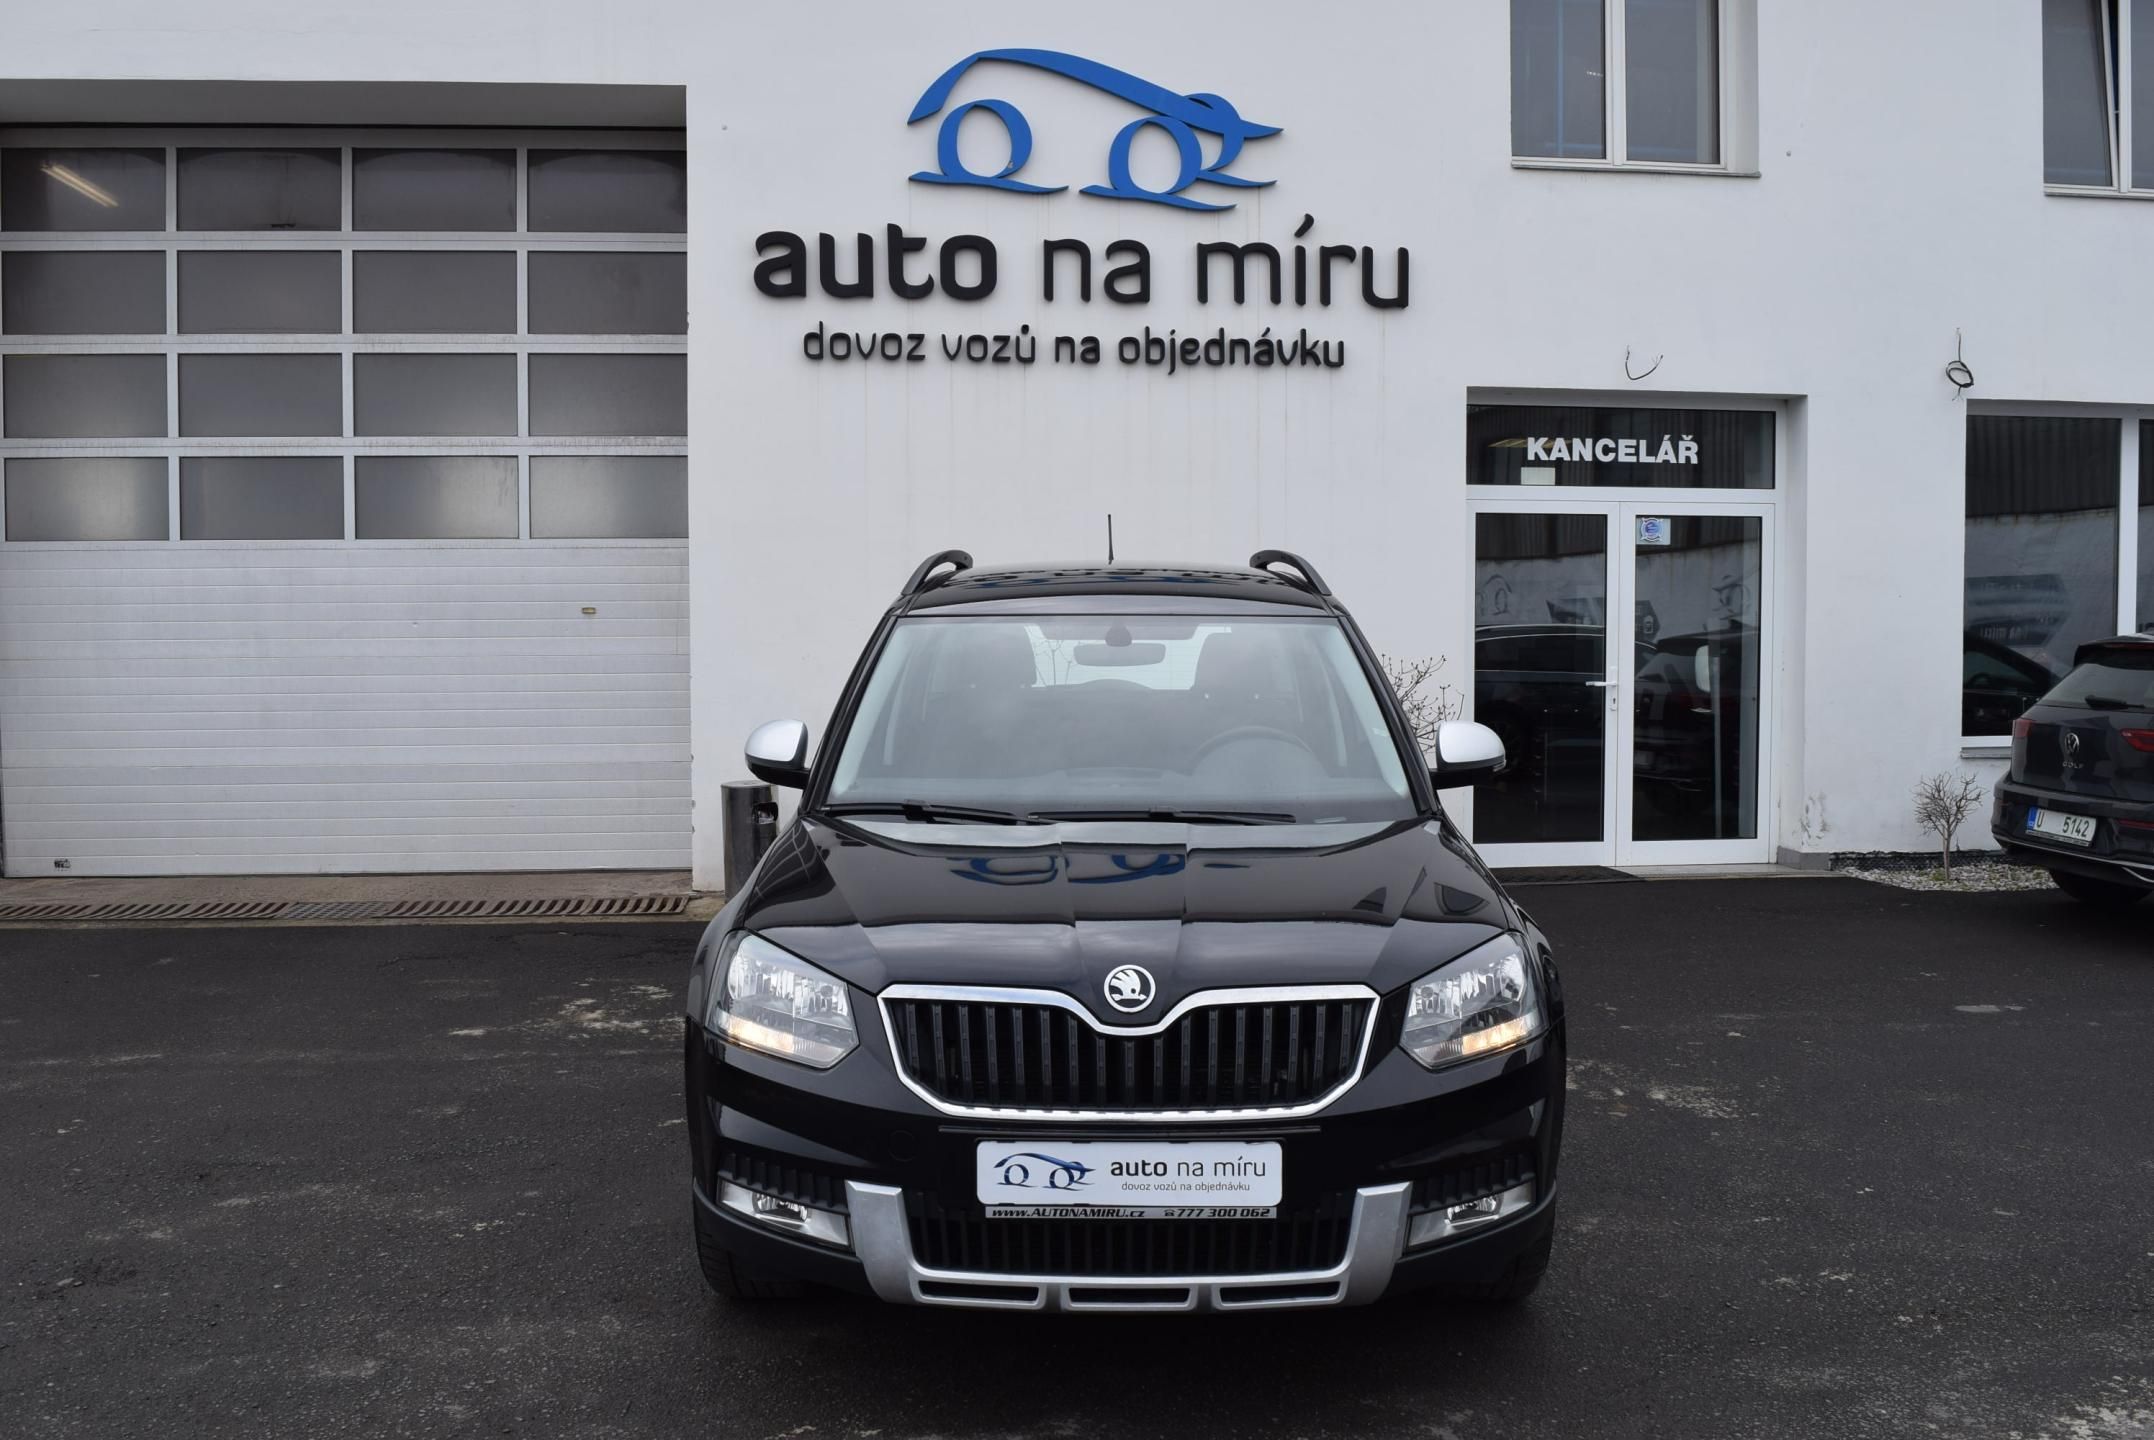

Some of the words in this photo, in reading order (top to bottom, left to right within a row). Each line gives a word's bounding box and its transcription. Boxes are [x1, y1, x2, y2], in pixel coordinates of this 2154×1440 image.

[753, 222, 998, 304] auto
[1043, 238, 1151, 306] na
[1196, 213, 1410, 310] míru
[803, 320, 926, 364] dovoz
[941, 324, 1036, 367] vozů
[1054, 335, 1101, 367] na
[1117, 325, 1345, 376] objednávku
[1527, 434, 1699, 465] KANCELÁŘ
[2062, 816, 2090, 838] 5142
[1110, 1159, 1168, 1177] auto
[1177, 1161, 1204, 1177] na
[1213, 1155, 1266, 1177] míru
[1121, 1181, 1151, 1191] dovoz
[1153, 1181, 1177, 1191] vozů
[1179, 1183, 1192, 1191] na
[1194, 1181, 1250, 1193] objednávku
[992, 1208, 1145, 1218] www.AUTONAMIRU.cz
[1178, 1208, 1204, 1218] 777
[1207, 1208, 1237, 1218] 300
[1240, 1208, 1271, 1218] 062
